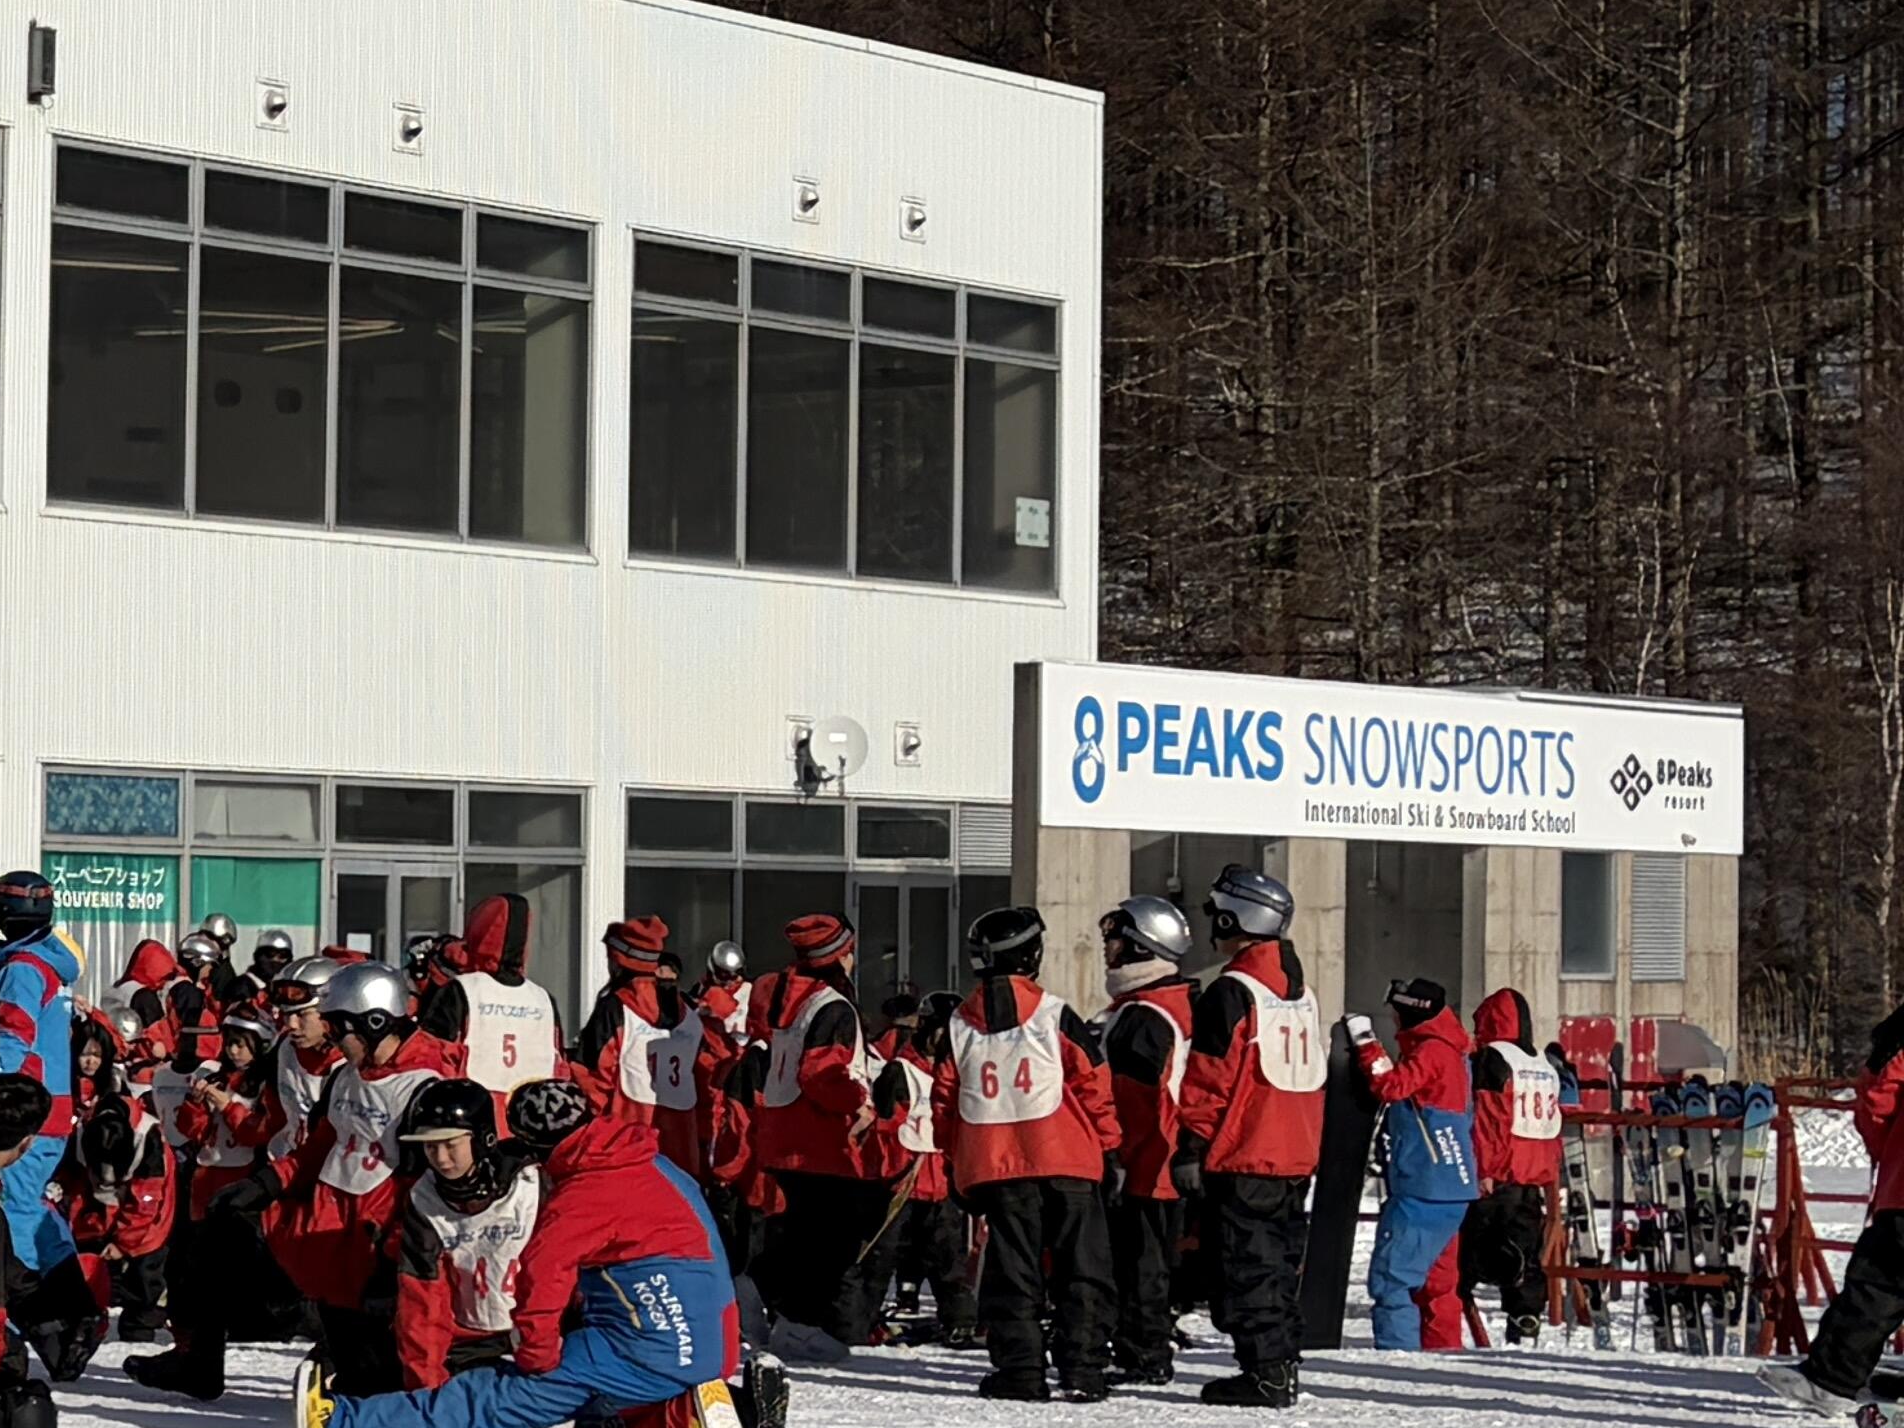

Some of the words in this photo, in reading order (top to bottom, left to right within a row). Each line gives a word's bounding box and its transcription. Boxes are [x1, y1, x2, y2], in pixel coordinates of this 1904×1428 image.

[1117, 699, 1284, 783] PEAKS
[1303, 711, 1575, 800] SNOWSPORTS
[1304, 798, 1403, 825] International
[1407, 802, 1430, 827] Ski
[1434, 805, 1445, 828] &
[1449, 805, 1527, 832] Snowboard
[1531, 808, 1576, 834] School
[1664, 795, 1705, 811] resort
[52, 889, 124, 909] SOUVENIR
[127, 892, 165, 910] SHOP
[503, 1033, 518, 1069] 5
[1279, 1025, 1308, 1066] 71
[980, 1056, 1033, 1100] 64
